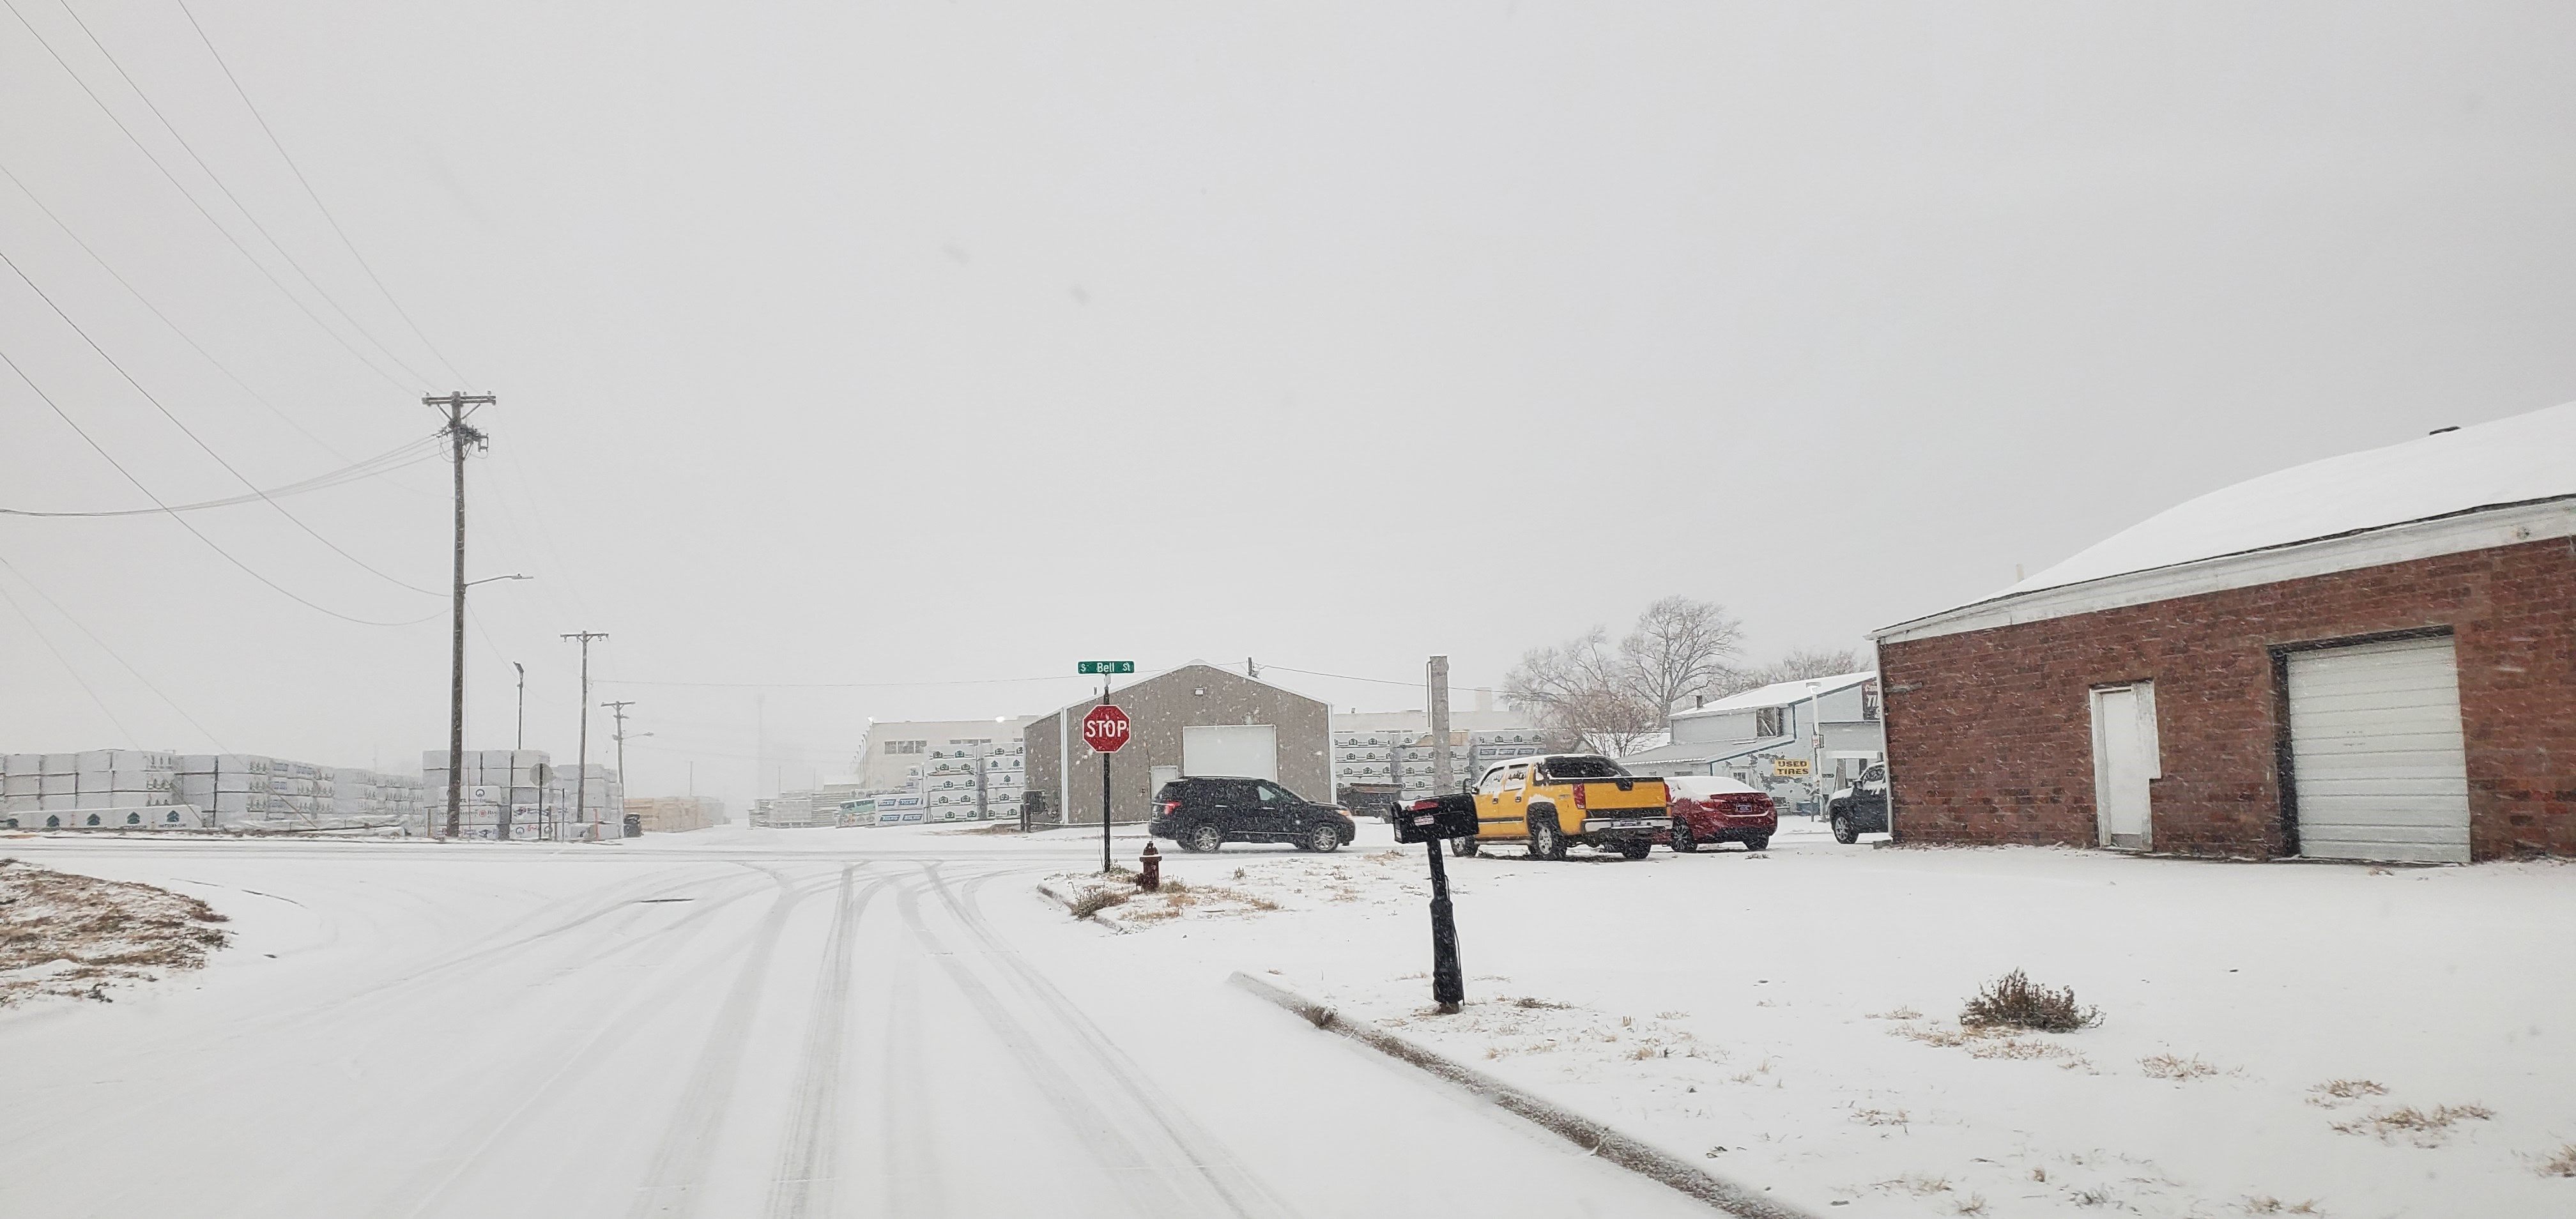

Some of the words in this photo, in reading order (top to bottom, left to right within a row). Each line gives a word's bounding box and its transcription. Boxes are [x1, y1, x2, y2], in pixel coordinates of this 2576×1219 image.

[1080, 663, 1086, 672] S
[1097, 662, 1115, 673] Bell
[1123, 662, 1131, 671] St
[1085, 720, 1127, 737] STOP
